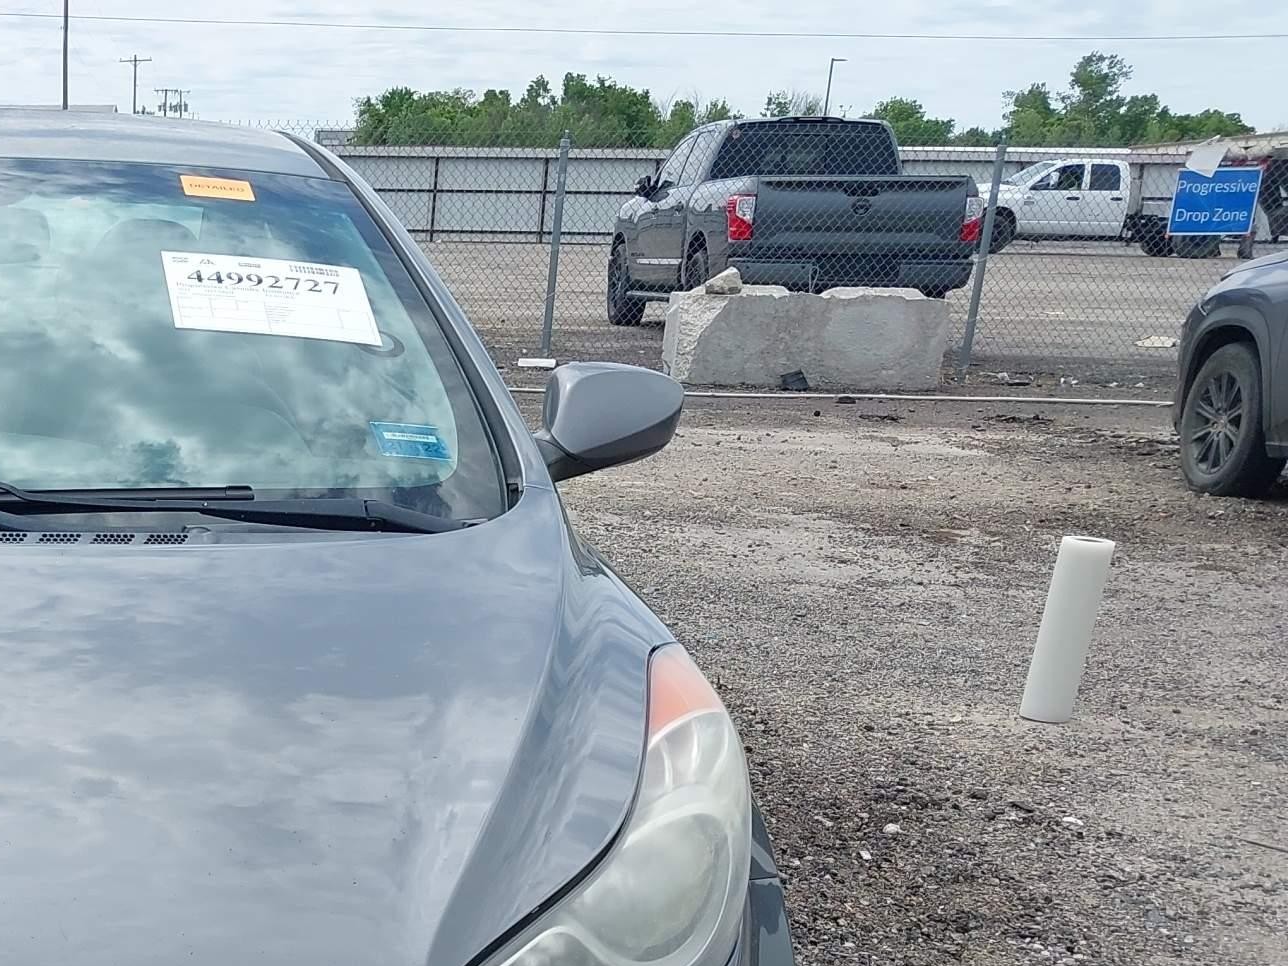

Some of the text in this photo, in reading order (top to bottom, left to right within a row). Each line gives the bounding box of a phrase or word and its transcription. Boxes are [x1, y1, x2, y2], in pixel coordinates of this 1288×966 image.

[1176, 179, 1258, 196] Progressive
[1174, 207, 1248, 224] Drop Zone
[187, 269, 340, 295] 44992727
